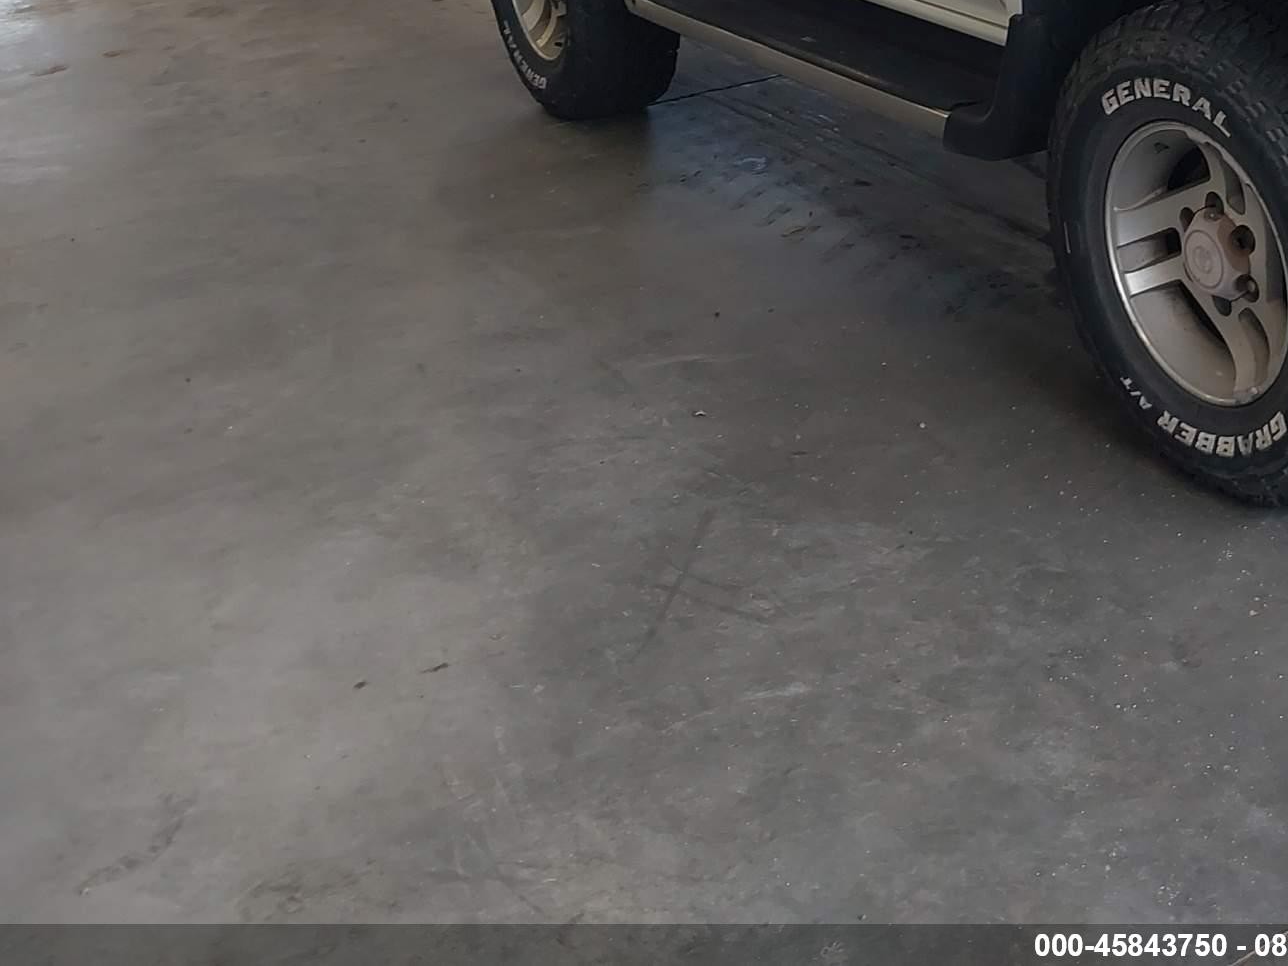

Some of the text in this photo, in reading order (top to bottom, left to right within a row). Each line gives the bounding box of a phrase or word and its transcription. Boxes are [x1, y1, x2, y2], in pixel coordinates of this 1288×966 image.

[1101, 77, 1231, 138] GENERAL
[1120, 376, 1288, 459] GRABBER A/T
